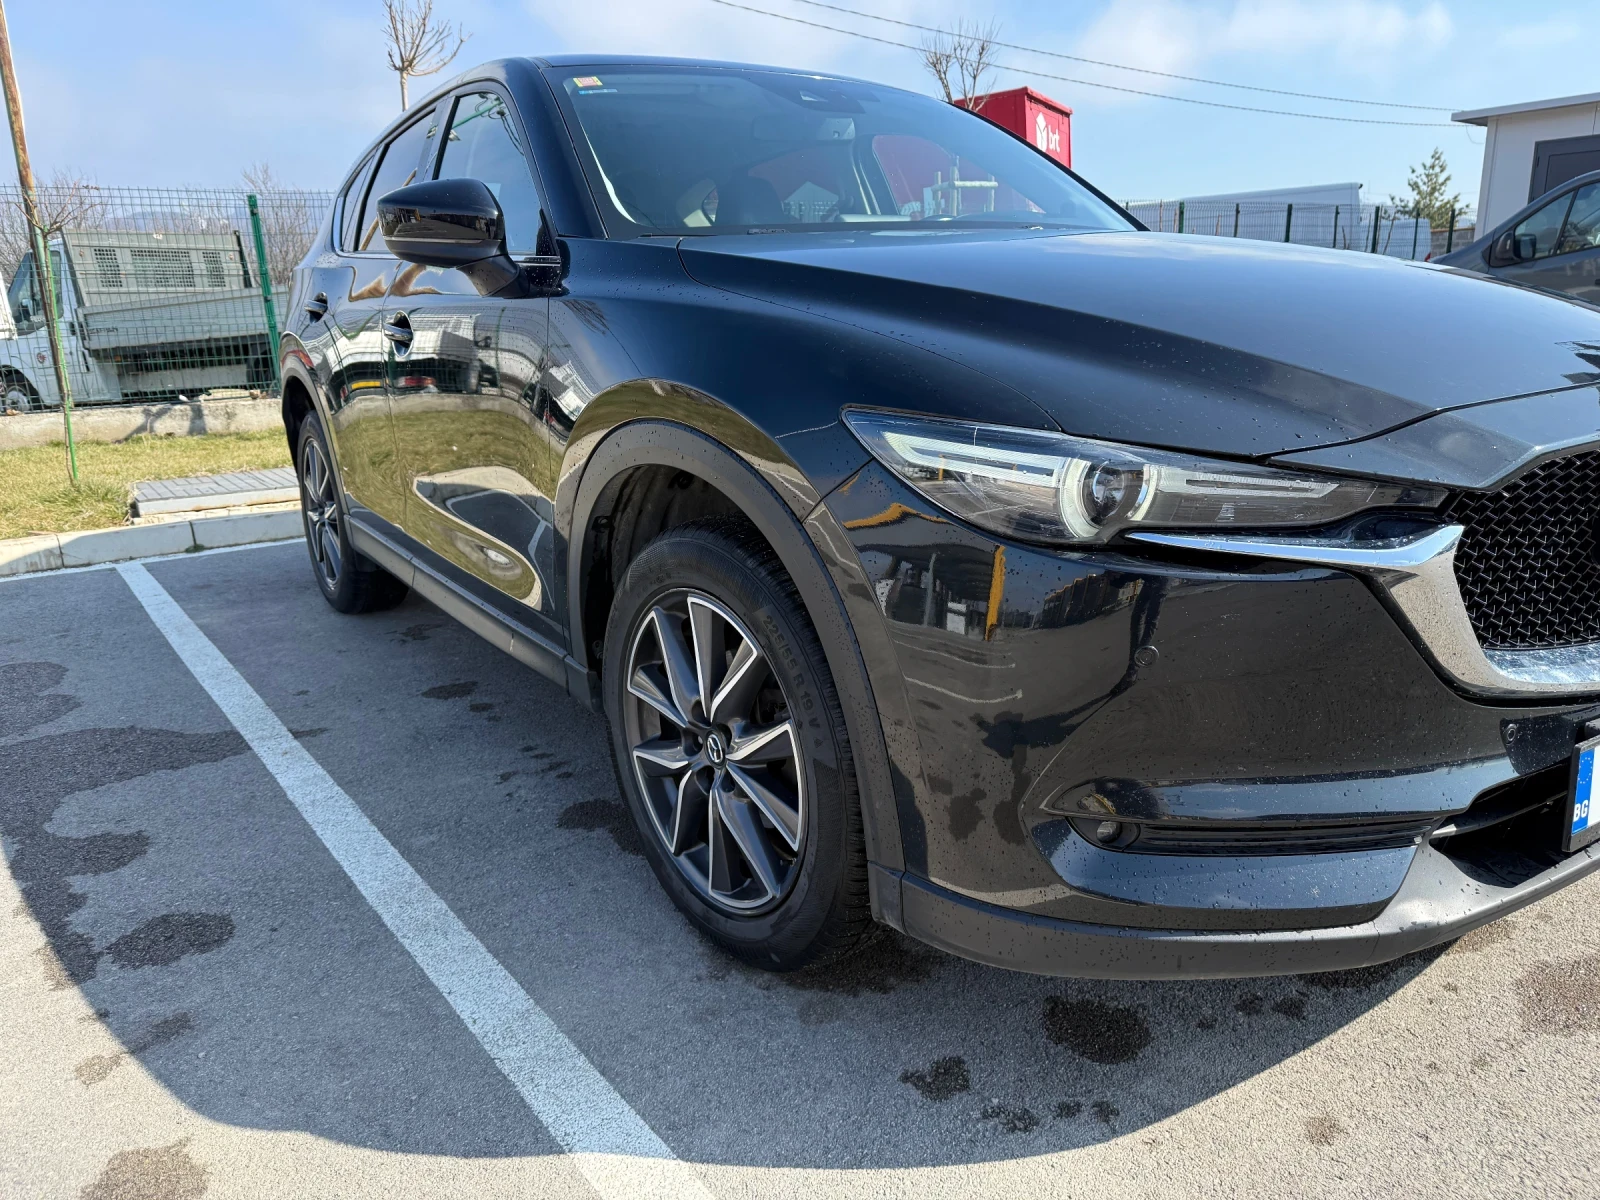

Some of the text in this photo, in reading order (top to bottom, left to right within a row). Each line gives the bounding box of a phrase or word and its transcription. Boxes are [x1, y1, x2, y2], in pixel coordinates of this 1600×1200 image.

[1048, 124, 1060, 153] brt
[793, 673, 805, 689] R
[1573, 800, 1588, 822] BG
